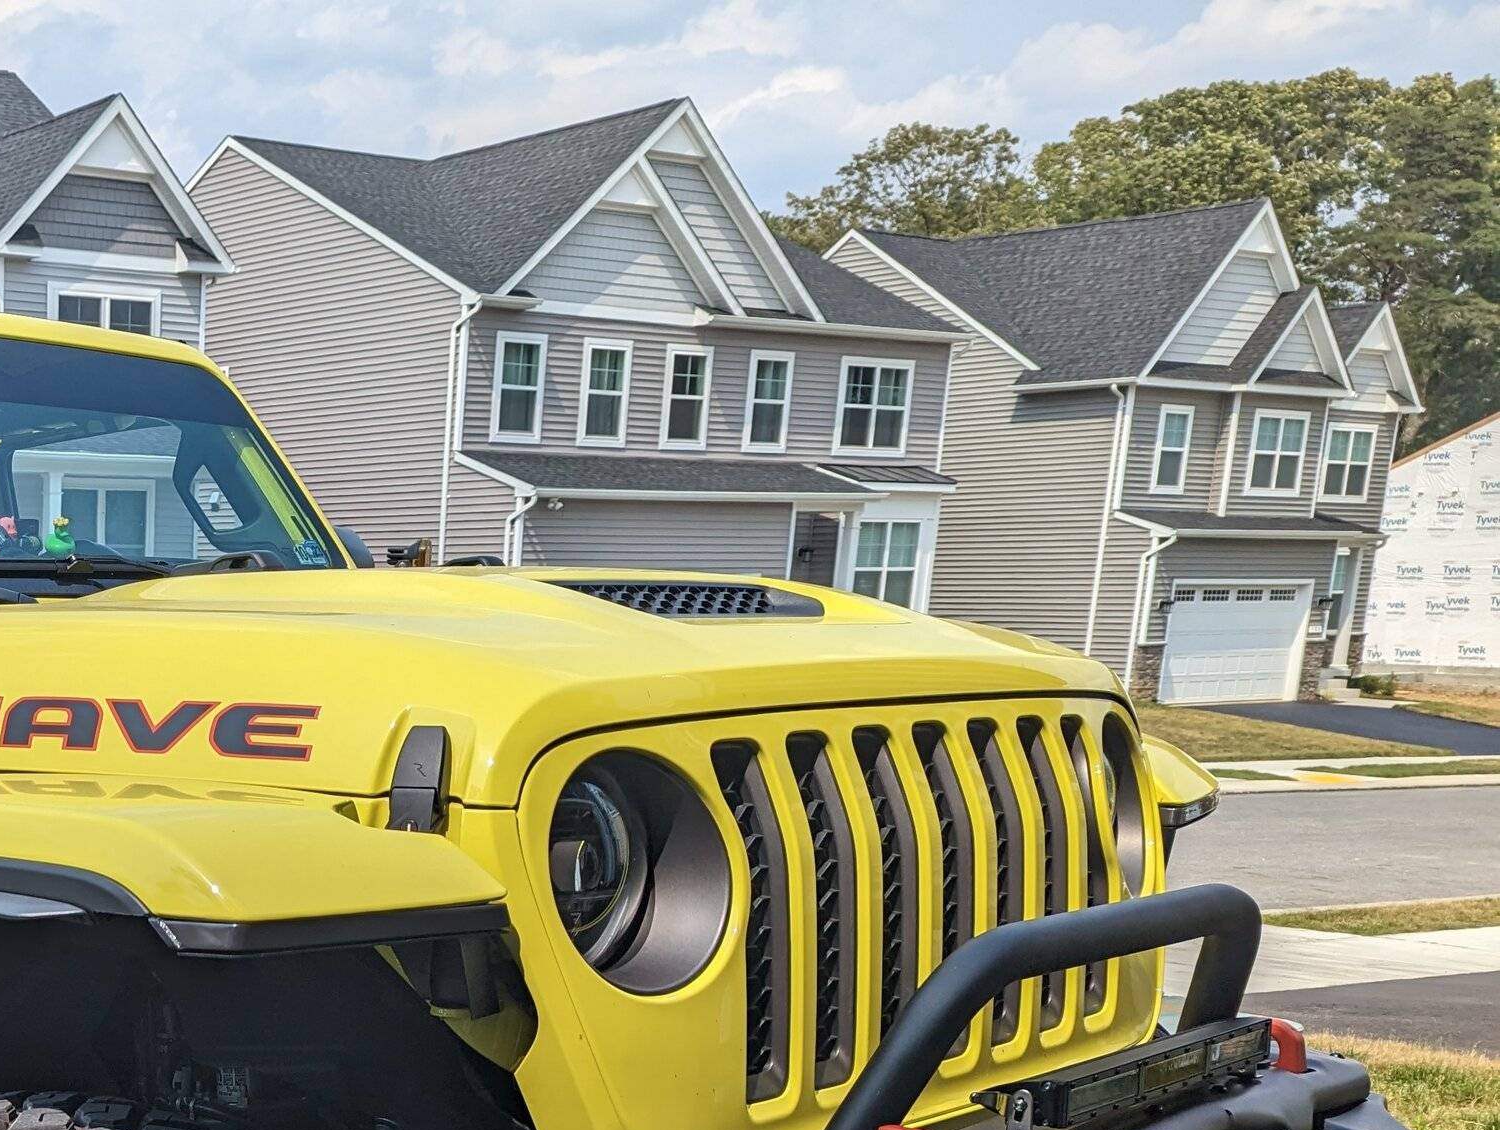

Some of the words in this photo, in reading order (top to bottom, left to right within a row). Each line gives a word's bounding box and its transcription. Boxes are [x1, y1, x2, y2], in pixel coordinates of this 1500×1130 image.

[1388, 485, 1411, 493] yvek
[1480, 480, 1500, 490] Tyve
[1436, 500, 1465, 509] Tyvek
[1382, 517, 1408, 526] Tyvek
[1396, 565, 1423, 575] Tyvek
[1443, 565, 1471, 575] Tyvek
[1446, 596, 1470, 606] yvek
[1395, 648, 1421, 657] Tyvek
[1458, 645, 1485, 655] Tyvek
